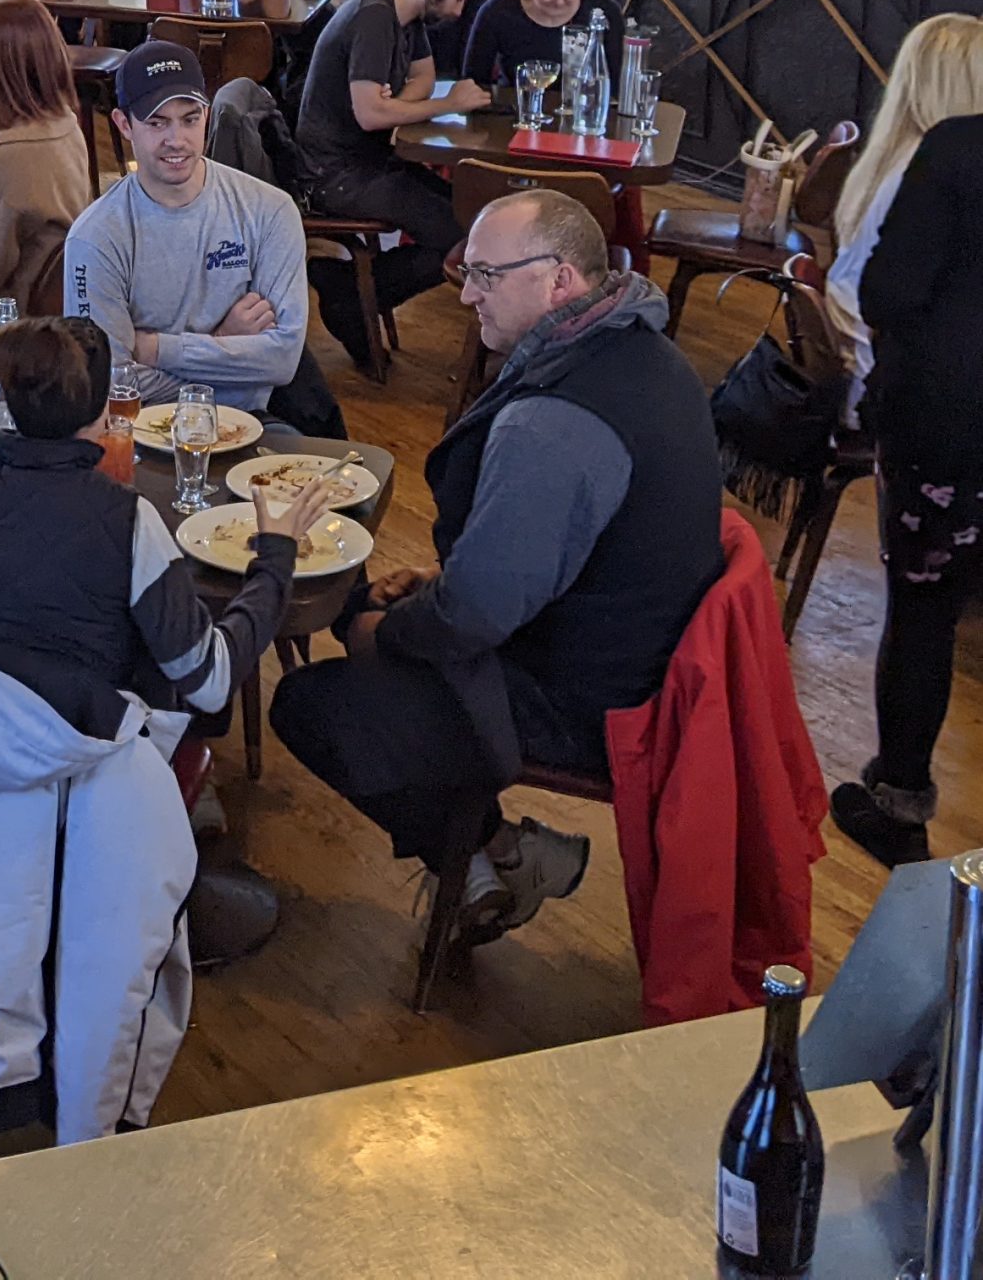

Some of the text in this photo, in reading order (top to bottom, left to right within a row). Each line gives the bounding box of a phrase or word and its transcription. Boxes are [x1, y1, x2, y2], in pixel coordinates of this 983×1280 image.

[207, 243, 246, 270] Knuckl
[75, 264, 91, 319] THE K
